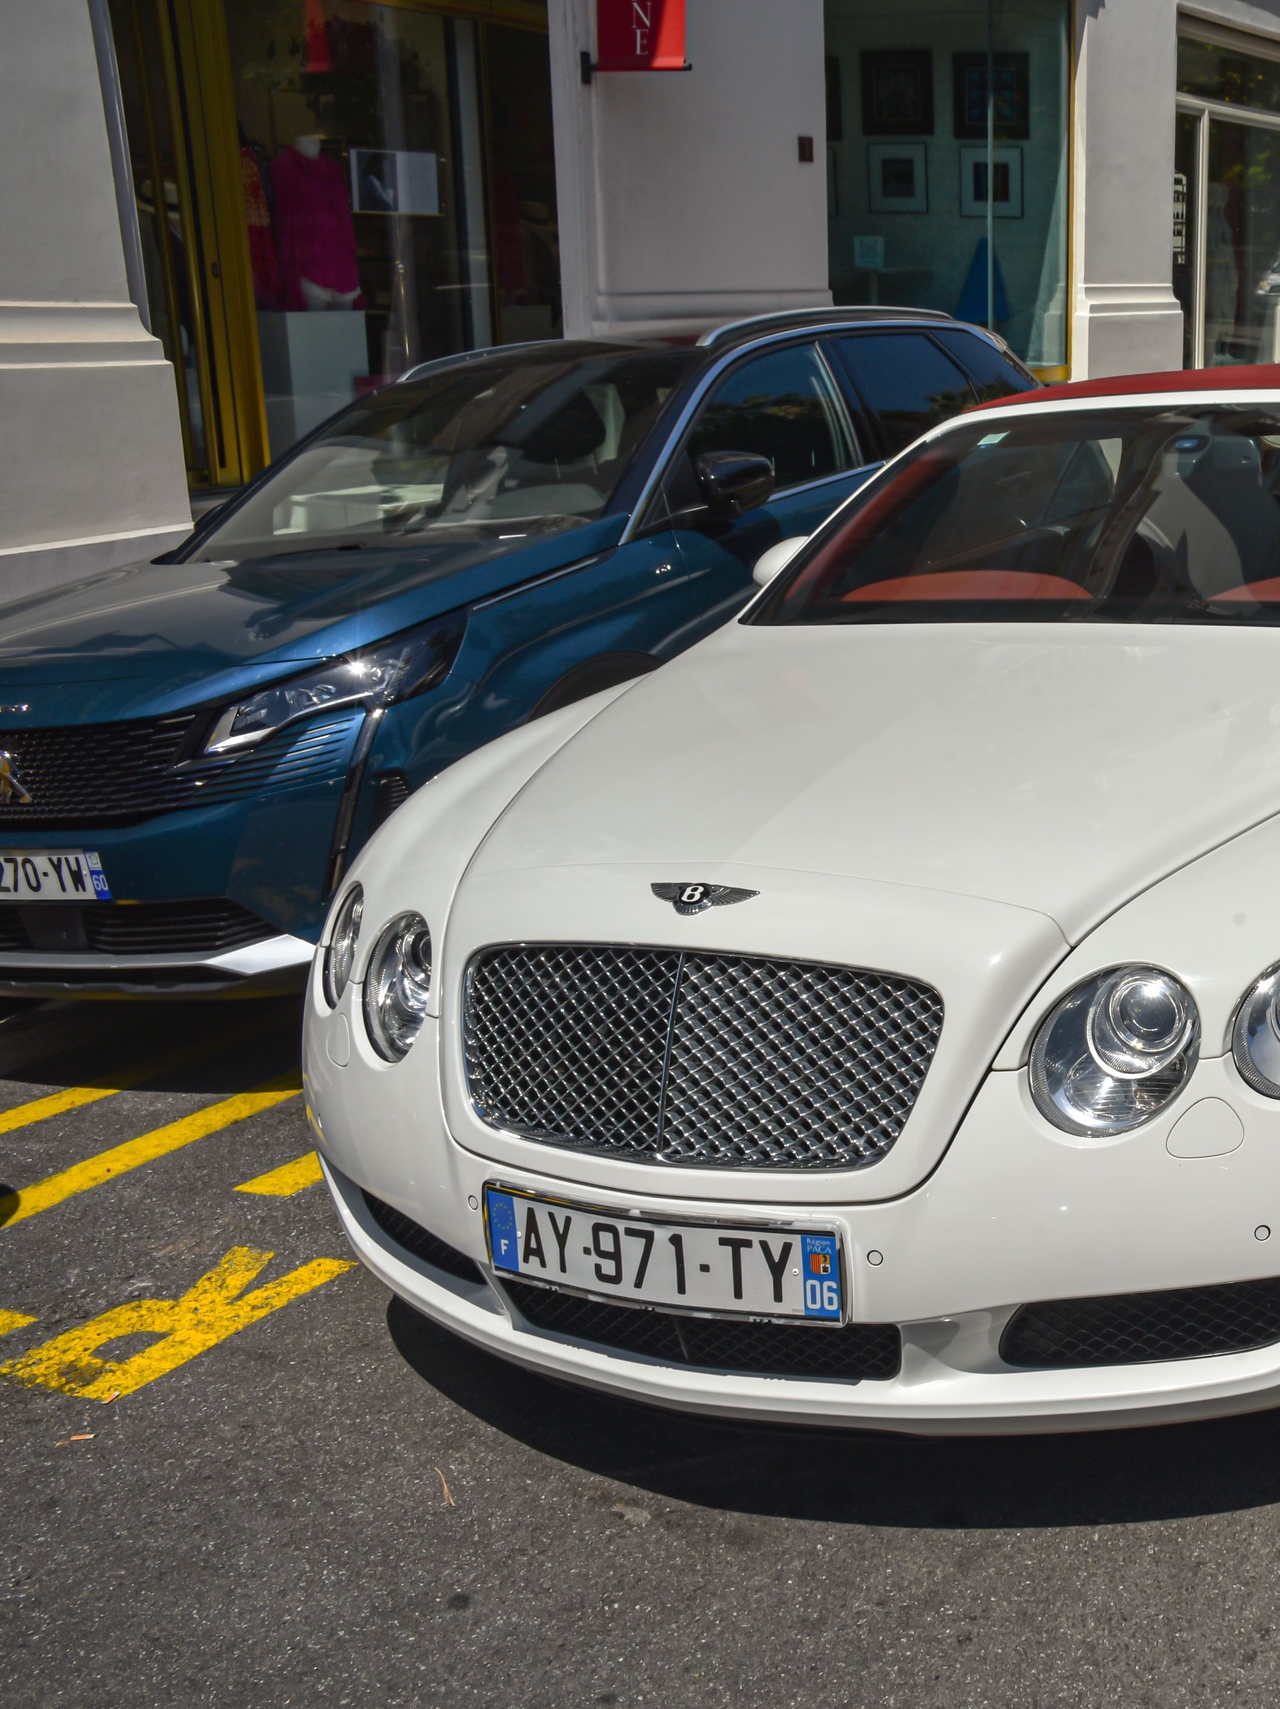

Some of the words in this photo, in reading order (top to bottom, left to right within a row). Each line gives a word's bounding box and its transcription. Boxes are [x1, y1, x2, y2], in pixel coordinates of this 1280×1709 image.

[92, 874, 109, 891] 60
[500, 1239, 509, 1255] F
[806, 1238, 831, 1247] Région
[806, 1245, 832, 1254] PACA
[522, 1206, 794, 1304] AY-971-TY
[805, 1279, 838, 1311] 06
